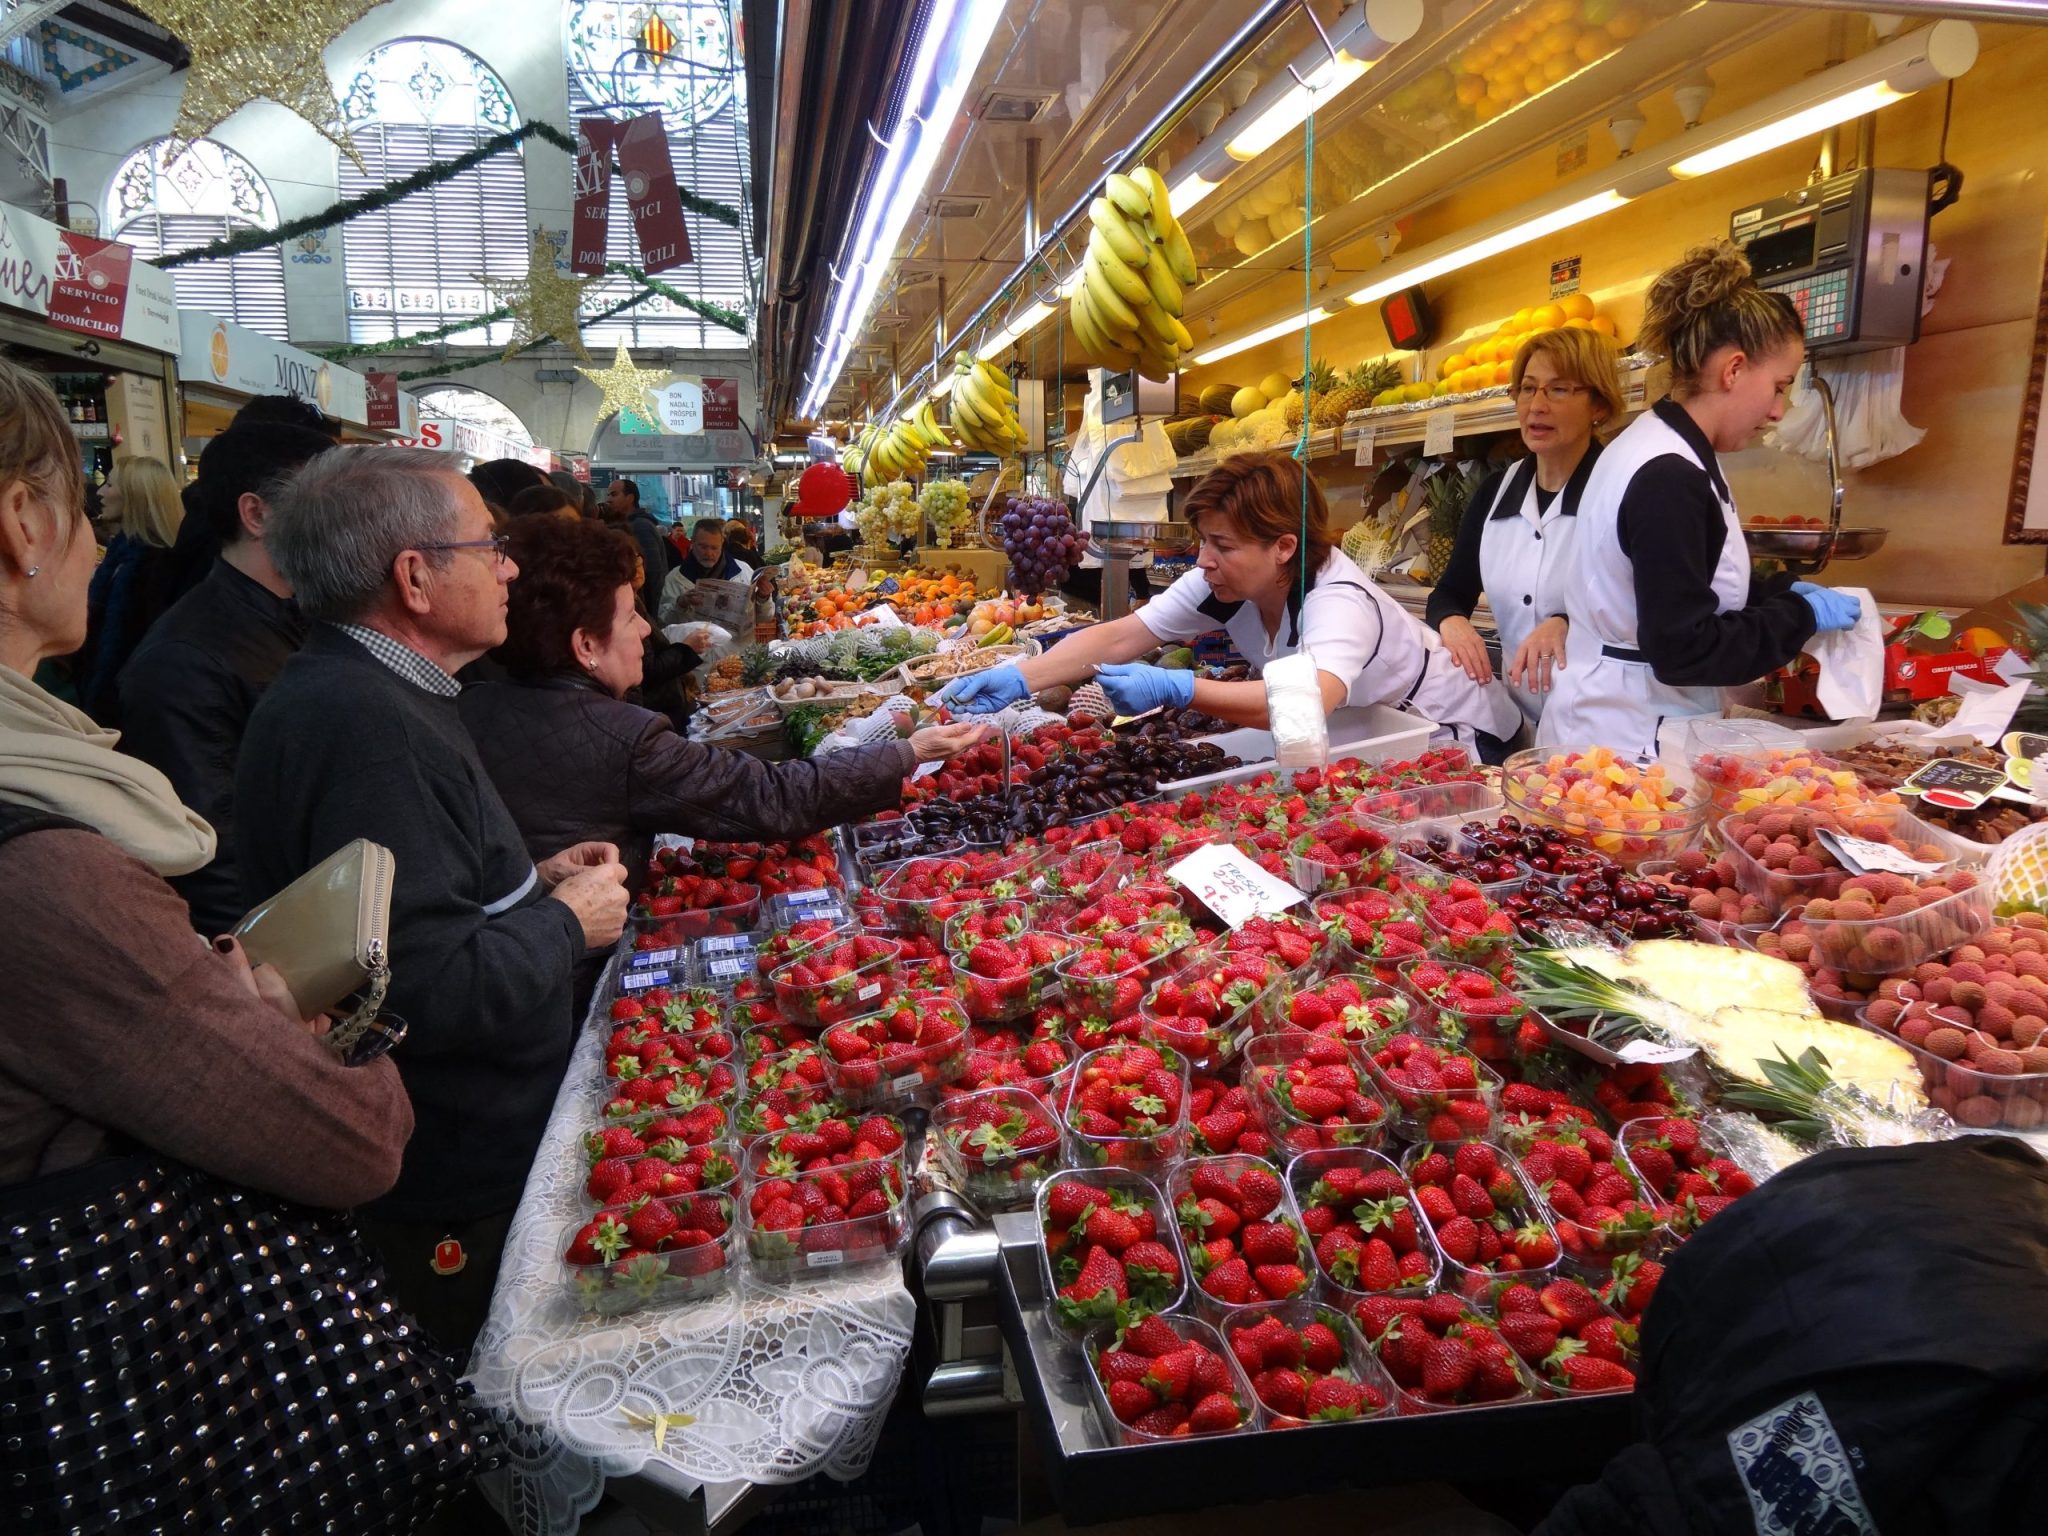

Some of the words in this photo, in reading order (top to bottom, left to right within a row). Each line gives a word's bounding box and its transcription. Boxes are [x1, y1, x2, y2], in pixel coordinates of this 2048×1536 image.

[59, 285, 119, 306] SERVICIO
[83, 304, 93, 314] A
[51, 311, 119, 335] DOMICILIO
[1219, 862, 1270, 901] FRESÓN
